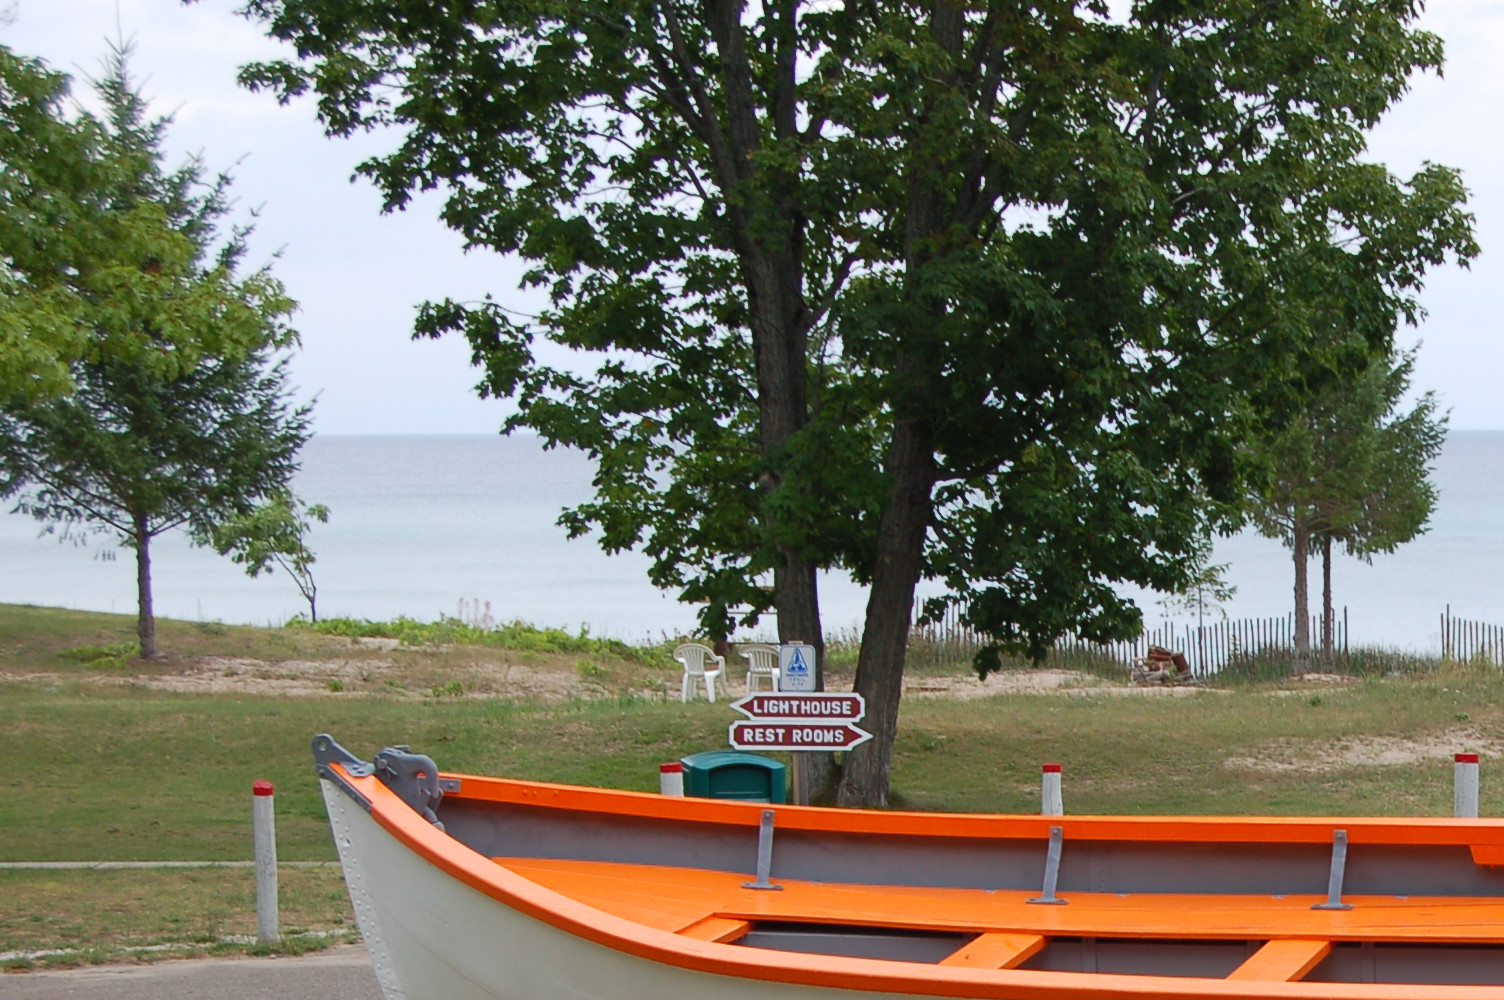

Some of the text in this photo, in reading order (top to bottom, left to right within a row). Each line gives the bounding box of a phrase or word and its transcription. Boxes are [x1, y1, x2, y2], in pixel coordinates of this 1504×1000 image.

[753, 700, 851, 715] LIGHTHOUSE
[743, 728, 844, 743] REST ROOMS
